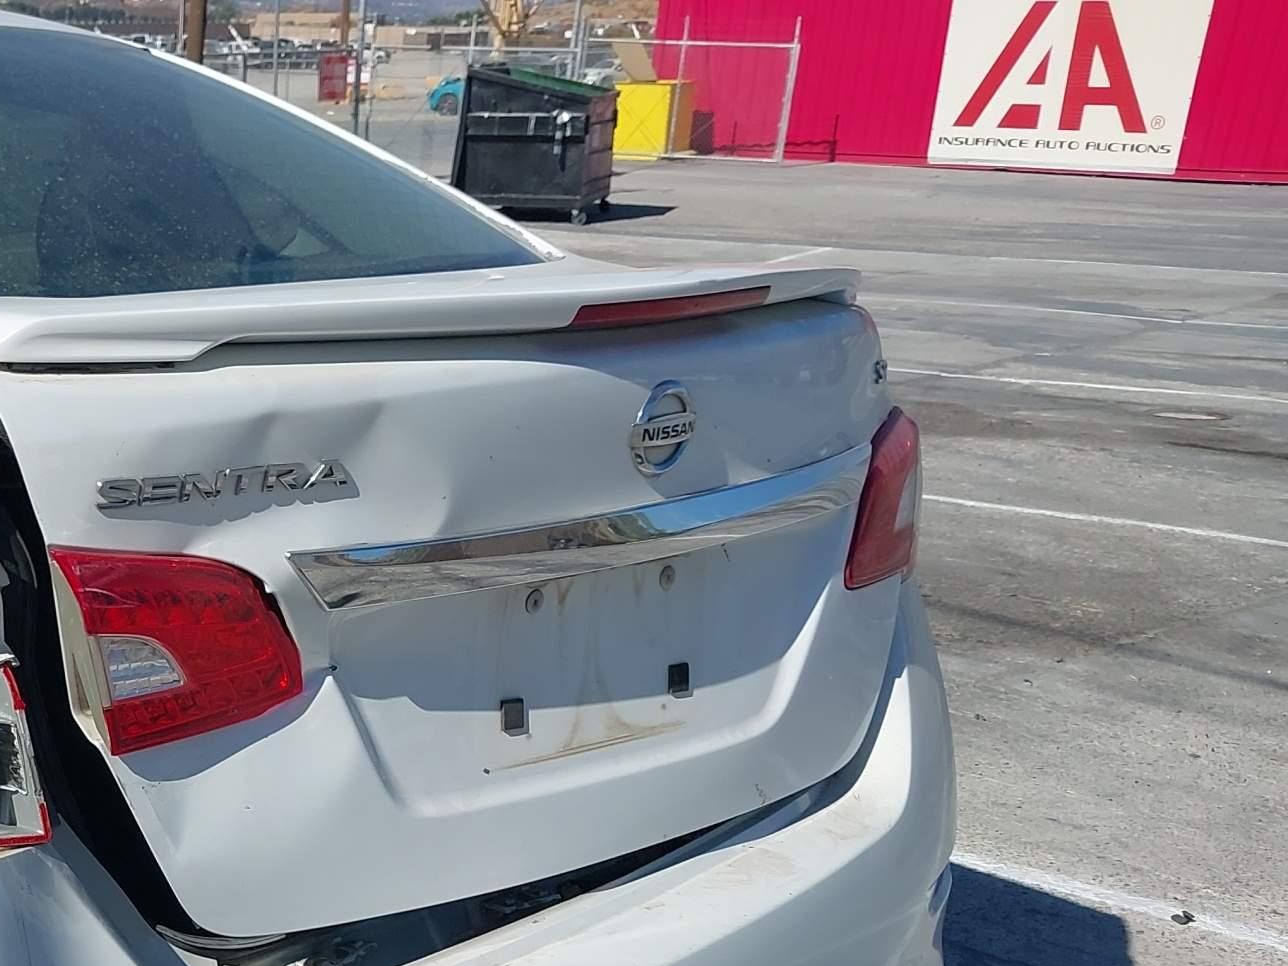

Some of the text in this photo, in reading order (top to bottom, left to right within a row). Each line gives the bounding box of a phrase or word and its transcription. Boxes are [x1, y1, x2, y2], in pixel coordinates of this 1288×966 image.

[937, 136, 1172, 154] INSURANCE AUTO AUCTIONS
[641, 420, 695, 442] NISSAN
[96, 458, 350, 511] SENTRA
